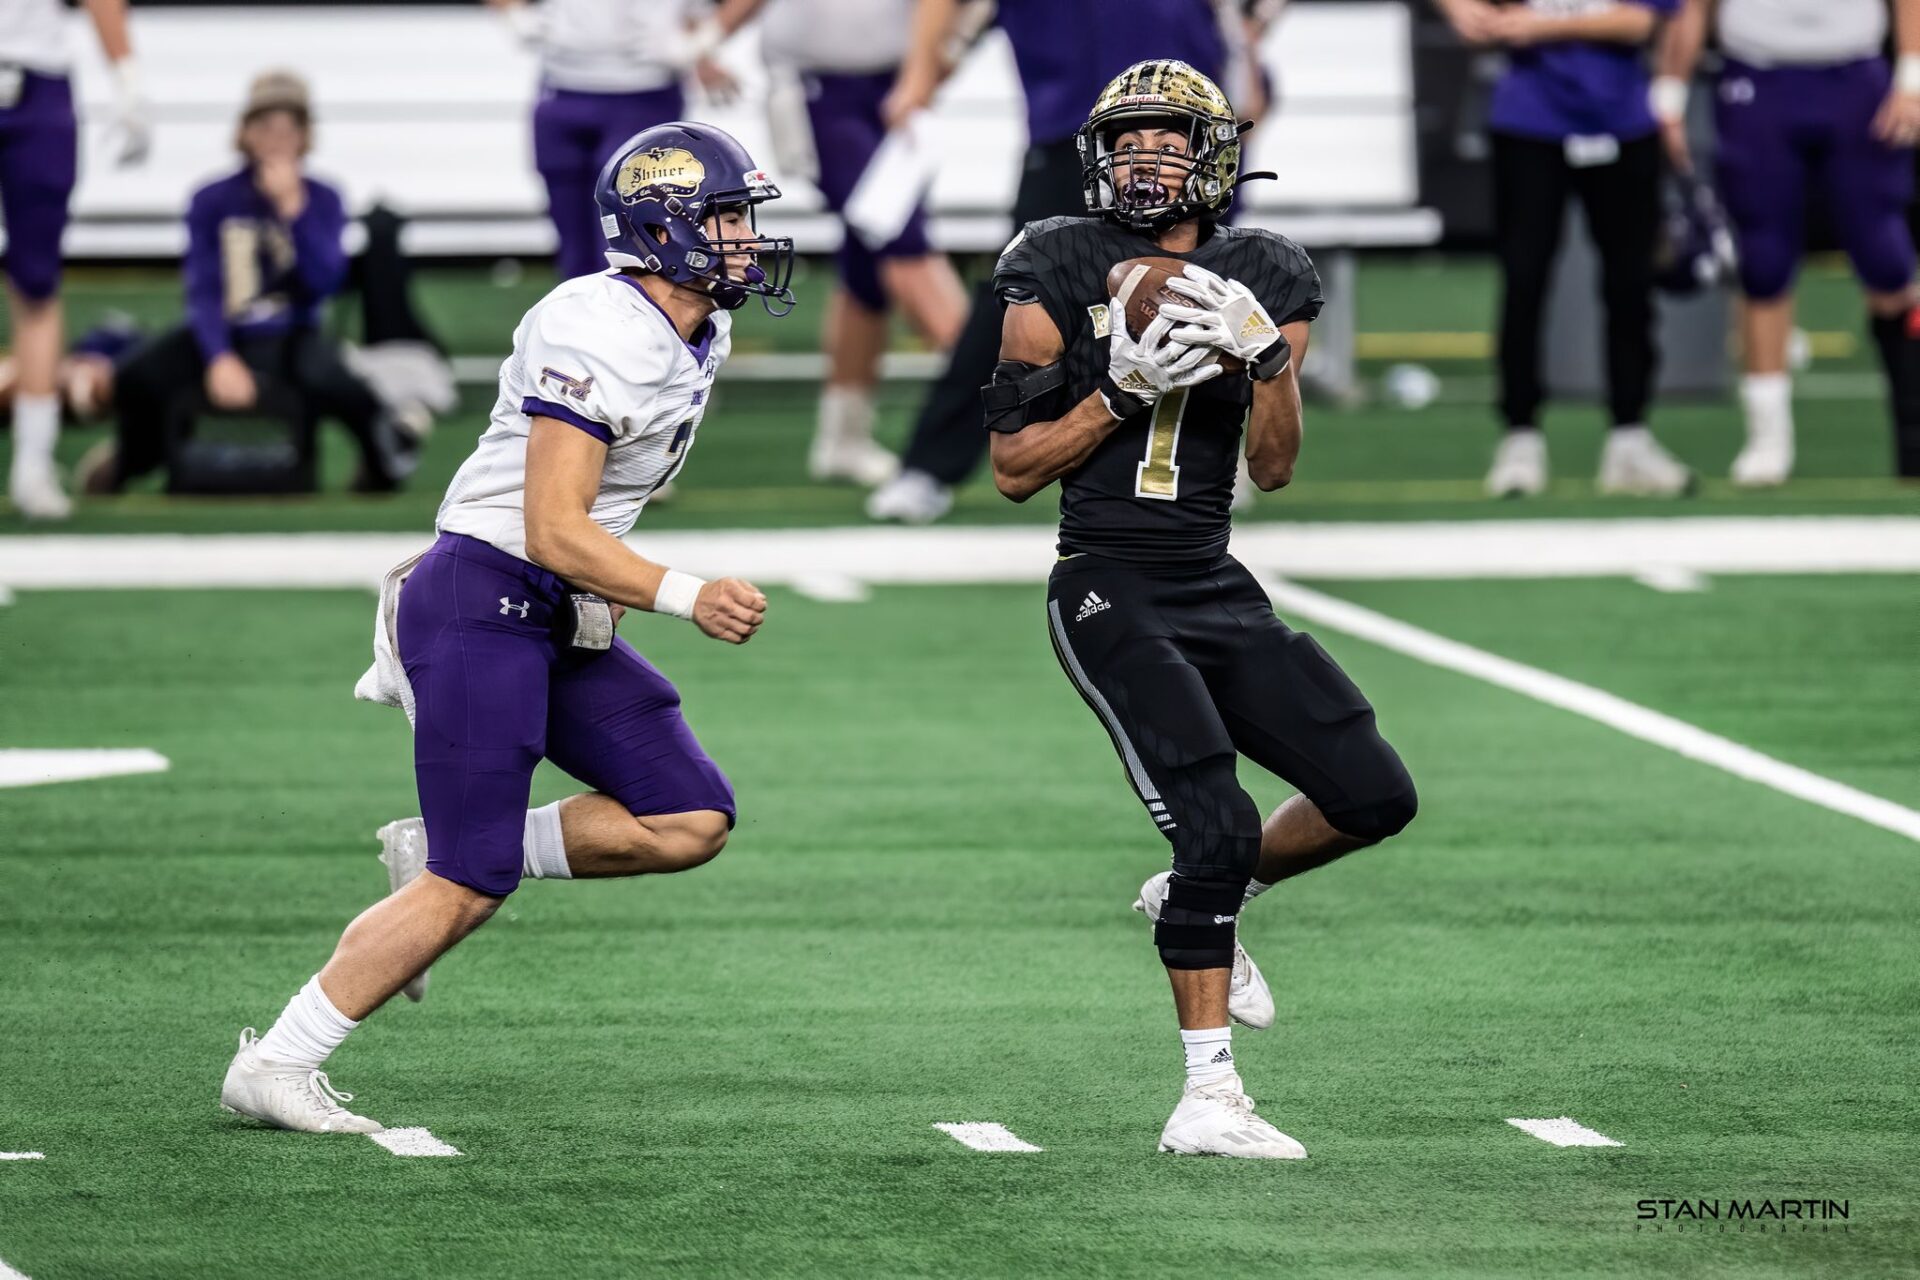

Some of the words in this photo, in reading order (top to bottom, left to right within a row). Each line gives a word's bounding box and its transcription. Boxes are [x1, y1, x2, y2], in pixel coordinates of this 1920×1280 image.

[1120, 95, 1160, 104] Riddell
[630, 167, 685, 188] Shiner
[1076, 601, 1111, 622] adidas
[1210, 1055, 1232, 1064] adida
